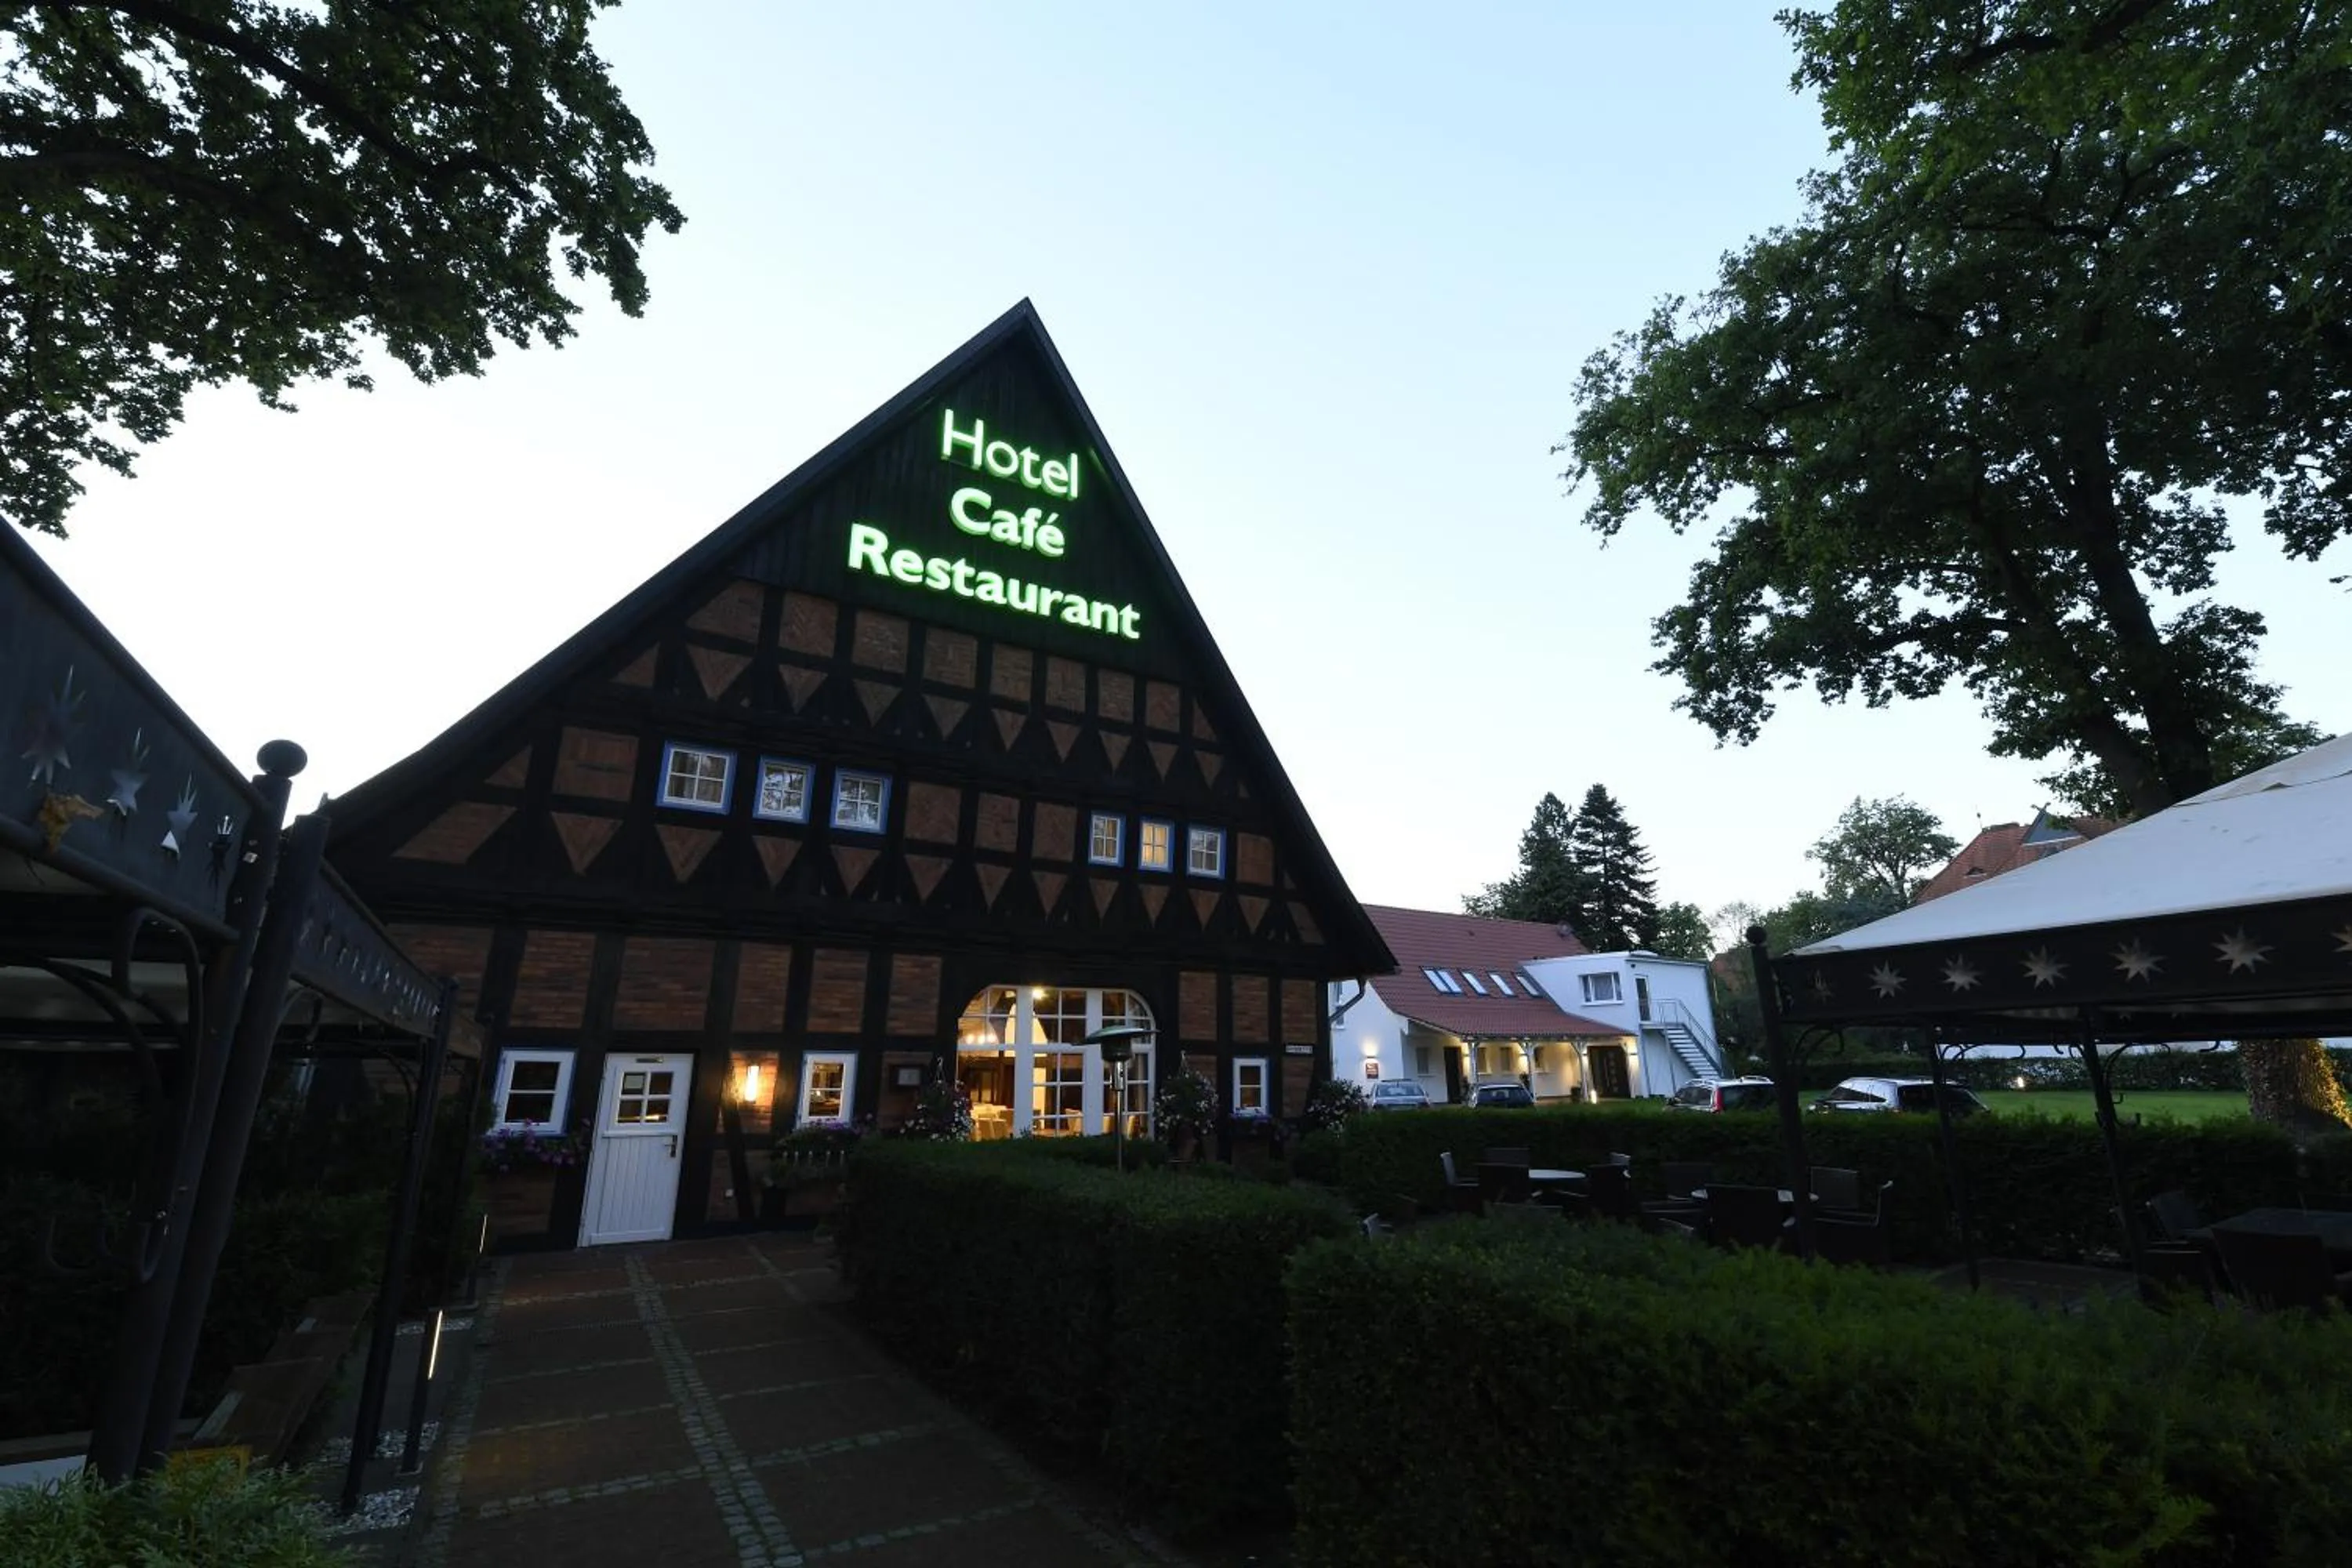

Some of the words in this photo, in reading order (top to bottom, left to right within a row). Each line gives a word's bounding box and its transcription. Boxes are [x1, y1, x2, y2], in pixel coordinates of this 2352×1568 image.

[942, 408, 1079, 500] Hotel
[949, 487, 1066, 557] Café
[848, 522, 1142, 640] Restaurant
